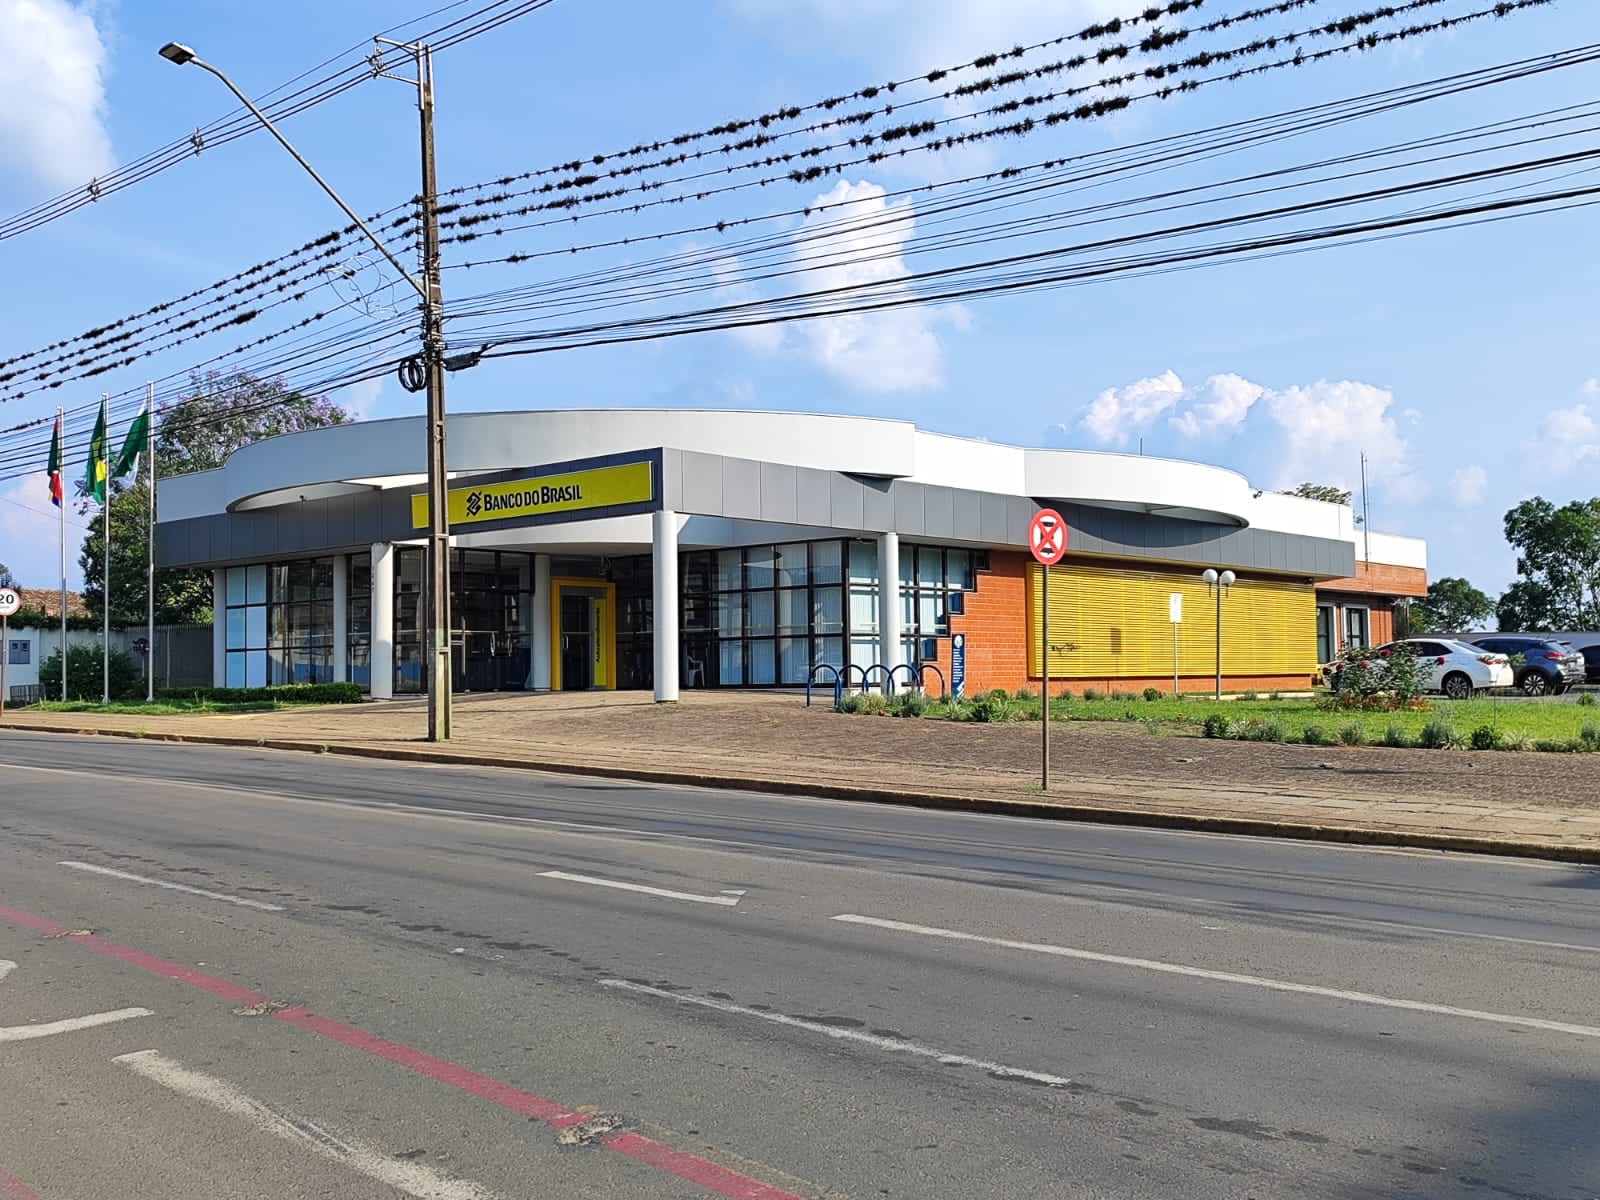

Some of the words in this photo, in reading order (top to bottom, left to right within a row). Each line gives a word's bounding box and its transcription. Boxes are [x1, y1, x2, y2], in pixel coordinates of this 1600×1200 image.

[484, 493, 522, 511] BANCO
[524, 490, 540, 506] DO
[541, 485, 582, 504] BRASIL
